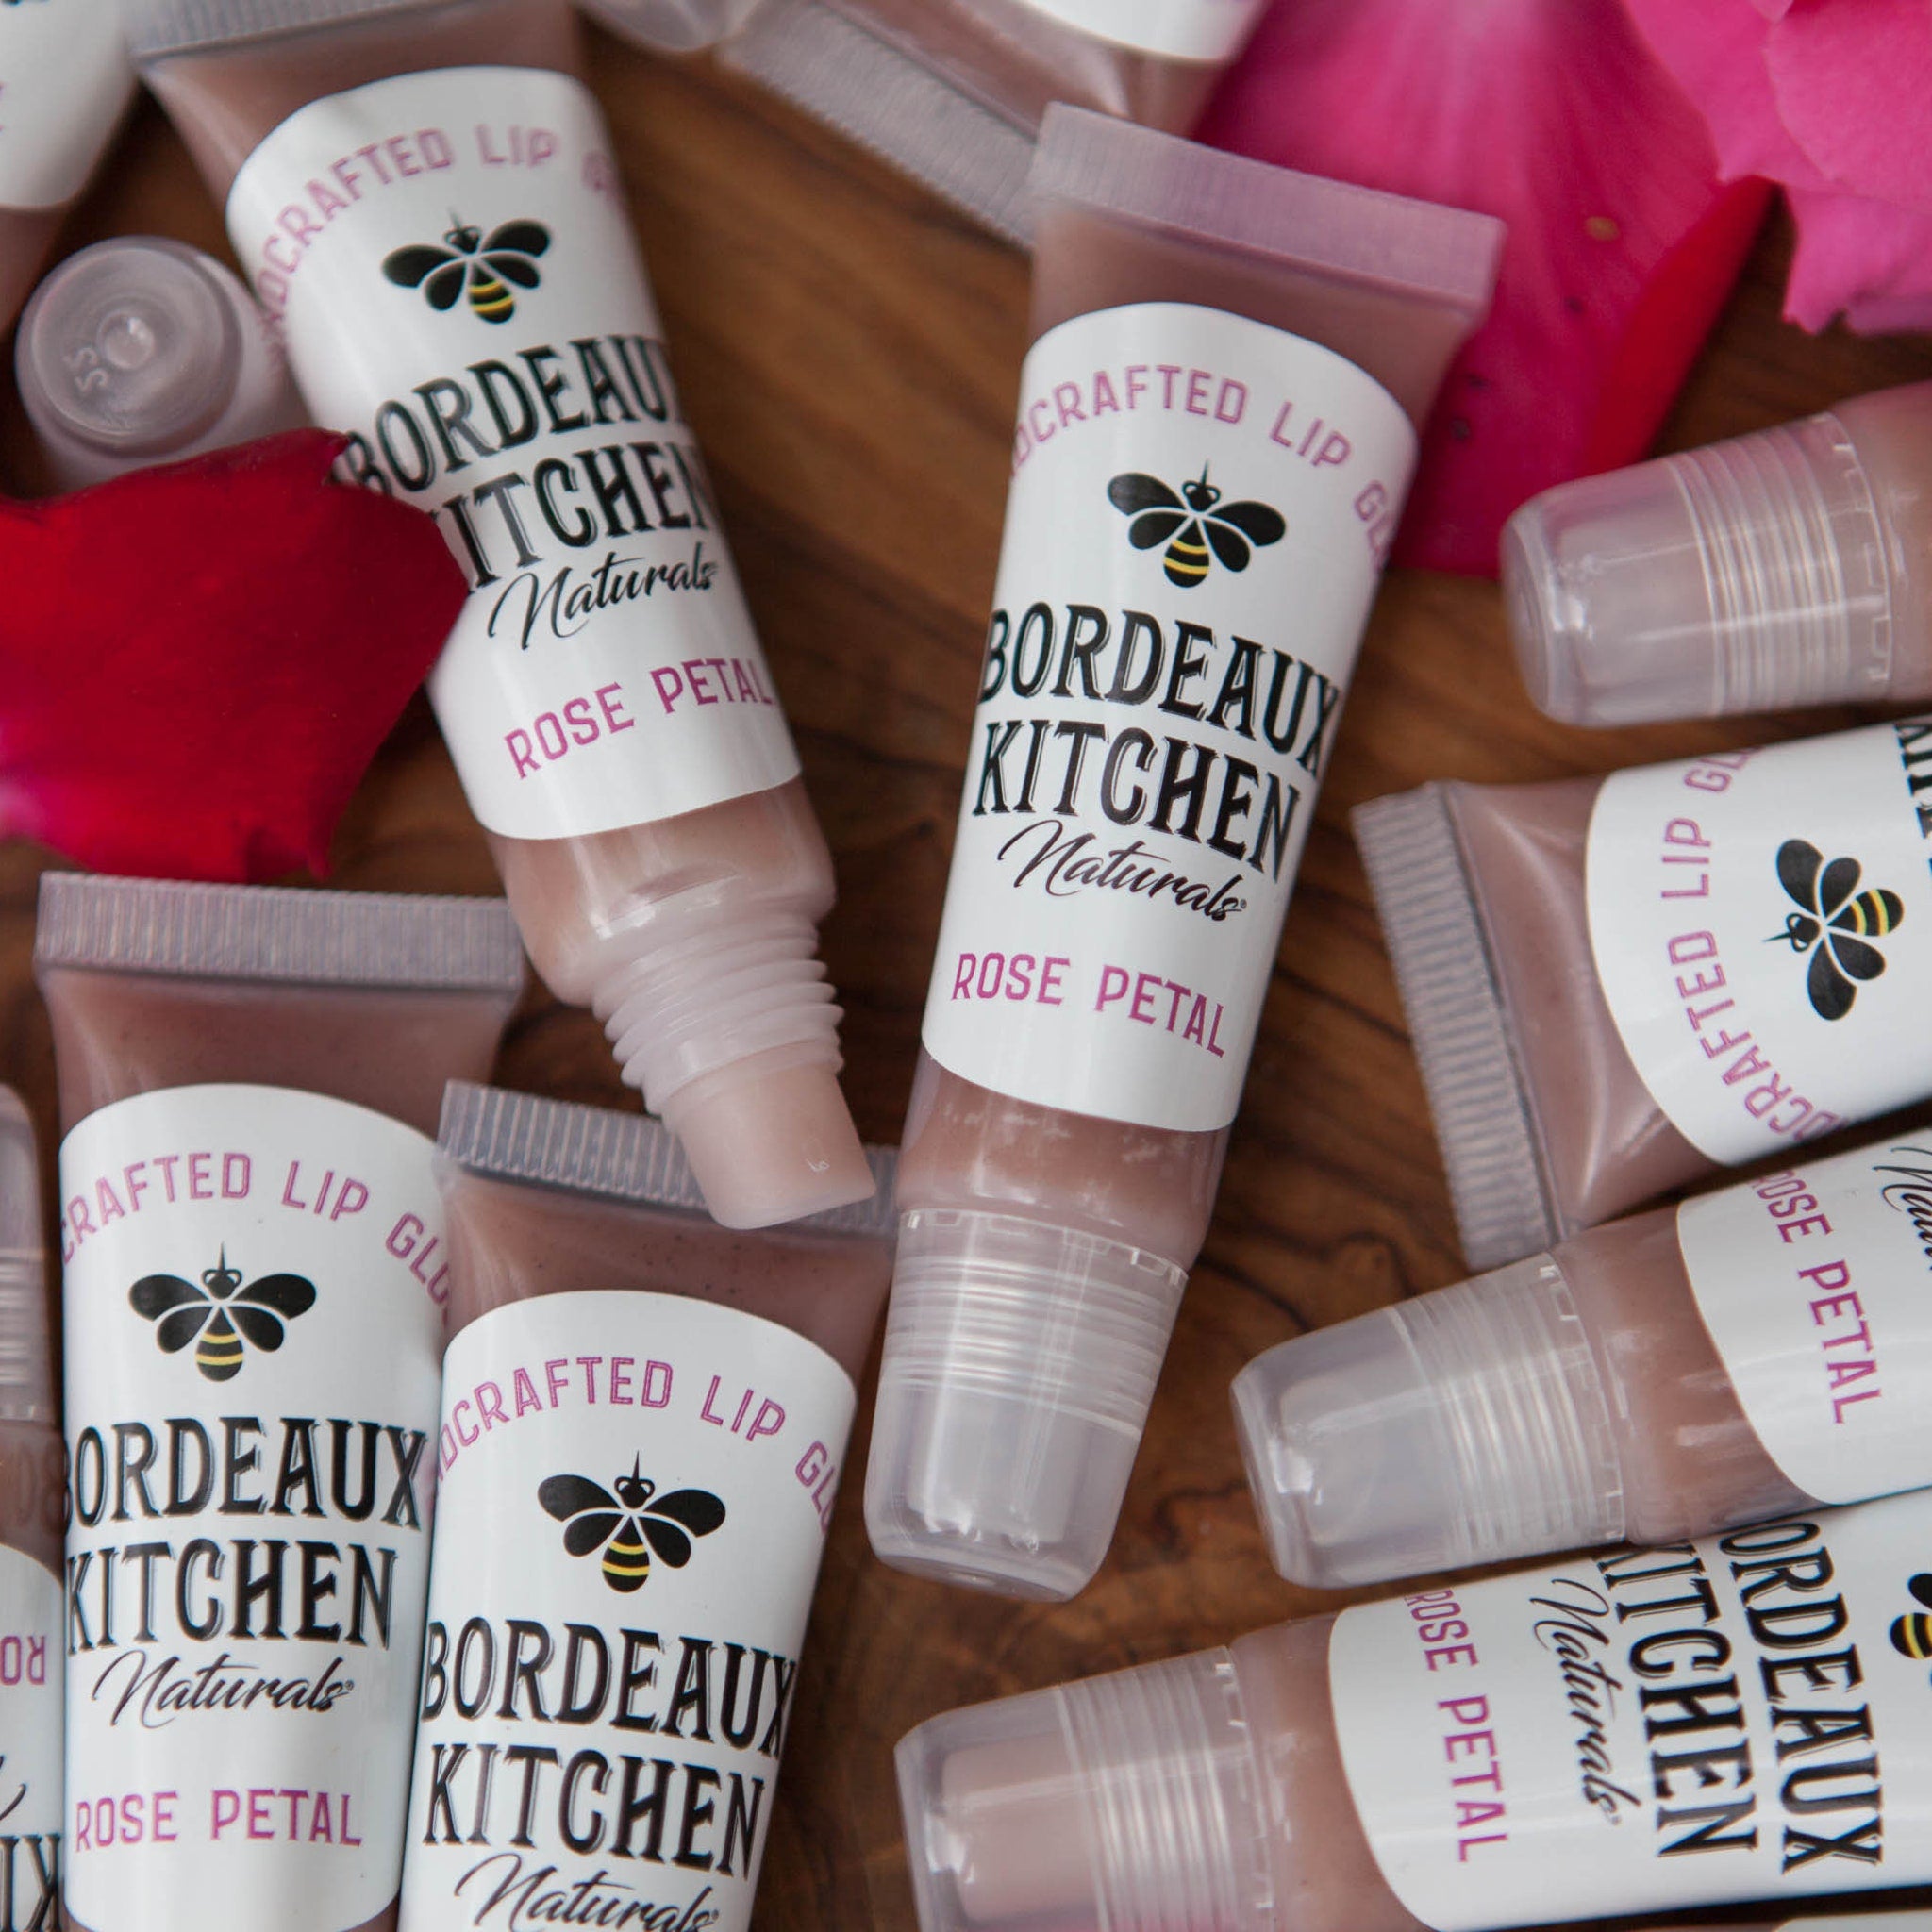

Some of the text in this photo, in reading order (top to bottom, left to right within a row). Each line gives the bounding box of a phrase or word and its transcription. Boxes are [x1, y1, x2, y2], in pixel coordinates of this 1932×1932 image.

[476, 125, 558, 167] LIP
[333, 335, 675, 494] BORDEAU
[1269, 401, 1352, 467] LIP
[431, 442, 709, 595] ITCHEN
[504, 658, 774, 779] ROSE PETAL
[977, 602, 1338, 778] BORDEAUX
[973, 719, 1300, 883] KITCHEN
[1661, 817, 1712, 899] LIP
[951, 952, 1225, 1058] ROSE PETAL
[281, 1160, 369, 1221] LIP
[1798, 1259, 1882, 1424] PETAL
[62, 1417, 428, 1532] ORDEAUX
[438, 1357, 674, 1482] DCRAFTED
[699, 1374, 786, 1441] LIP
[67, 1539, 398, 1656] KITCHEN
[421, 1616, 796, 1759] BORDEAUX
[1404, 1589, 1509, 1863] ROSE PETAL
[75, 1789, 363, 1852] ROSE PETAL
[422, 1743, 766, 1881] KITCHEN
